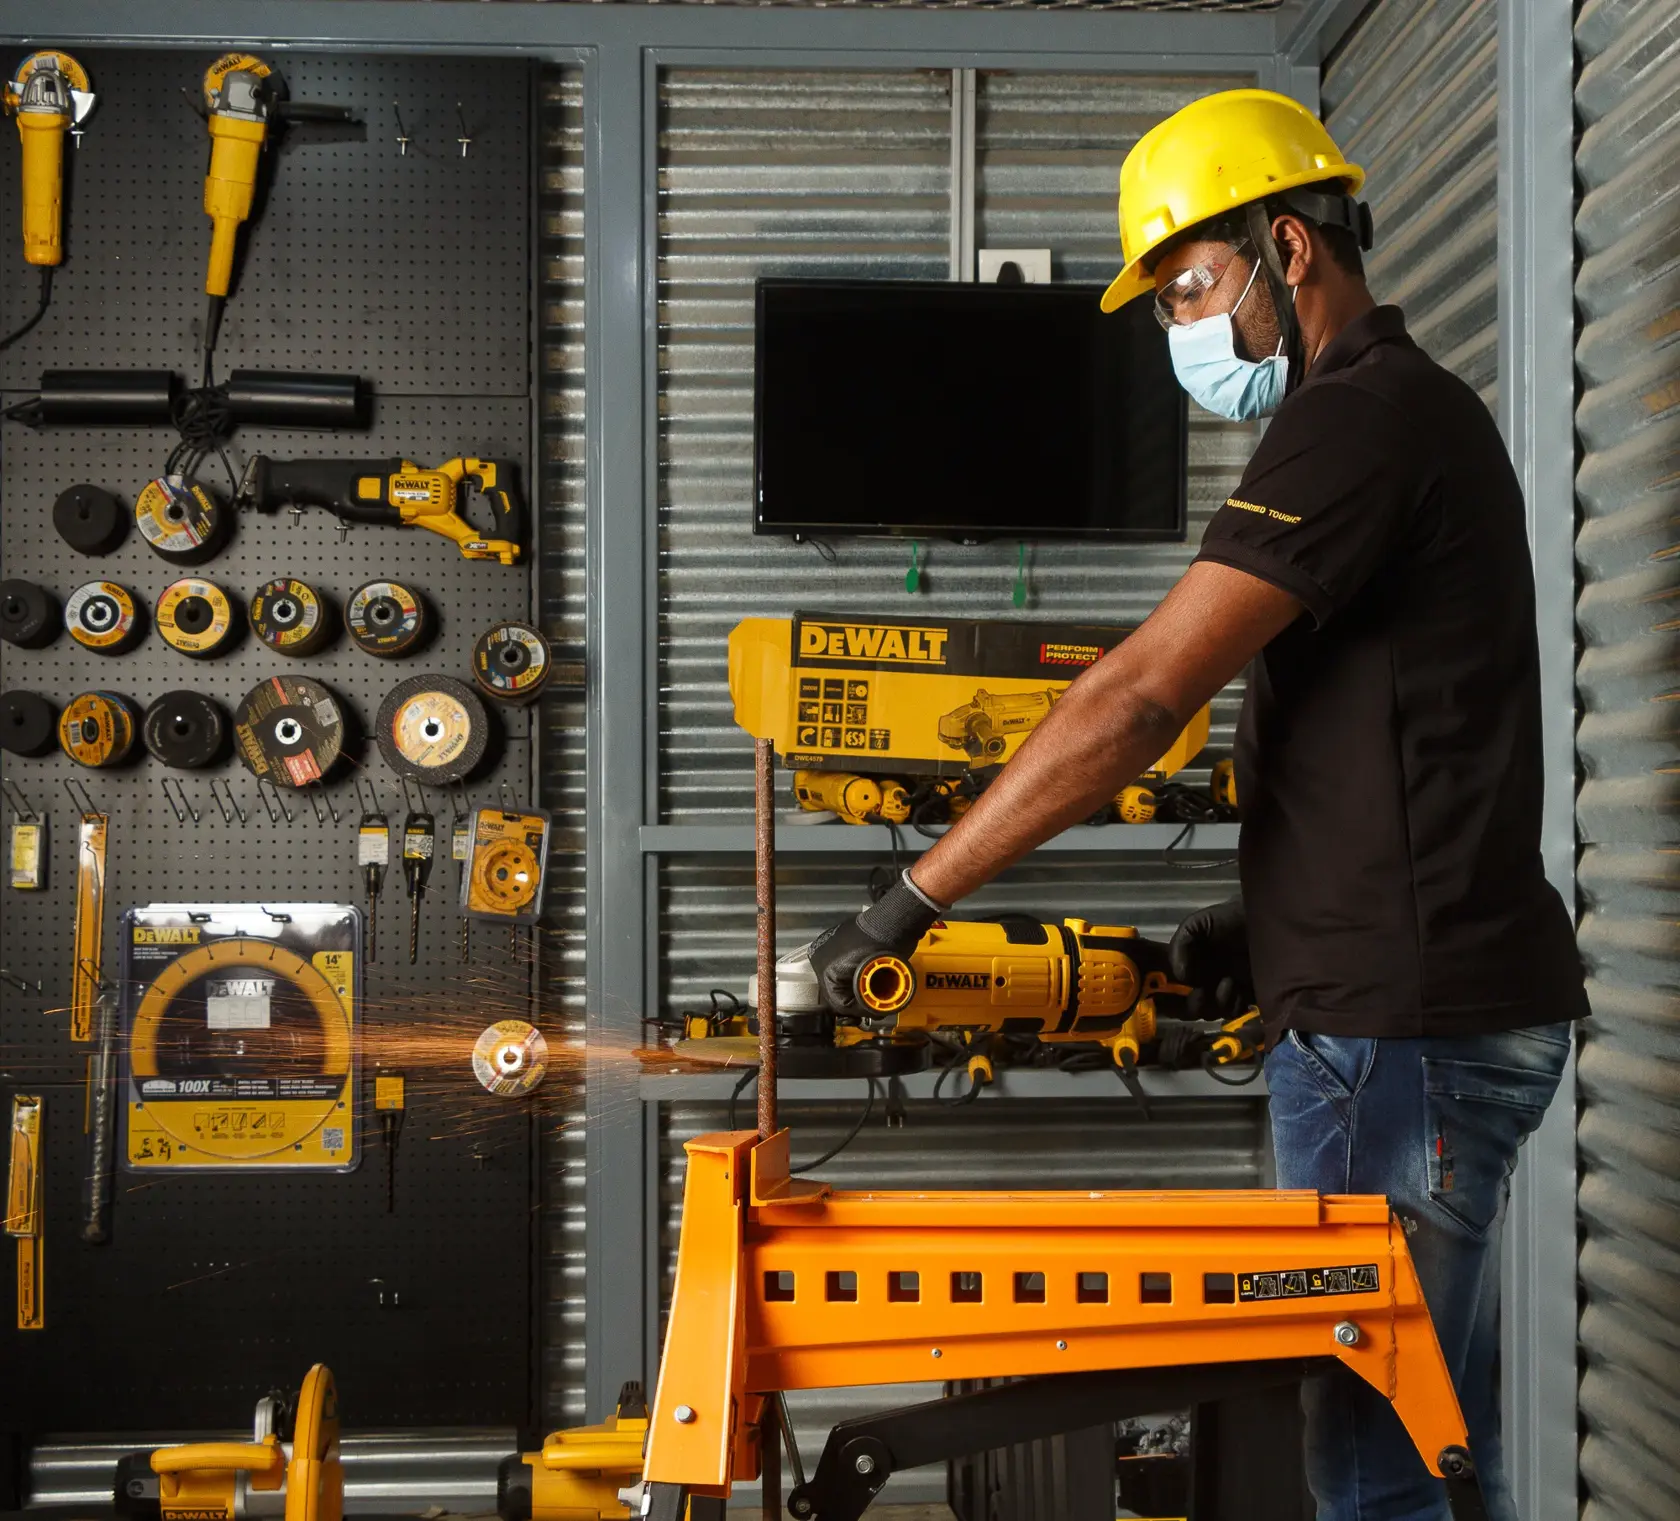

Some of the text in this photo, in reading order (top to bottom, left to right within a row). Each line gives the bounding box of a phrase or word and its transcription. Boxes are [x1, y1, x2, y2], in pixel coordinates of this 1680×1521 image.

[394, 479, 430, 489] DEWALT
[800, 624, 948, 661] DEWALT
[1046, 643, 1099, 653] PERFORM
[1045, 651, 1098, 661] PROTECT
[235, 722, 269, 776] DEWALT
[132, 927, 200, 943] DEWALT
[925, 973, 990, 989] DEWALT
[178, 1079, 211, 1093] 100X
[165, 1510, 225, 1520] DEWALT
